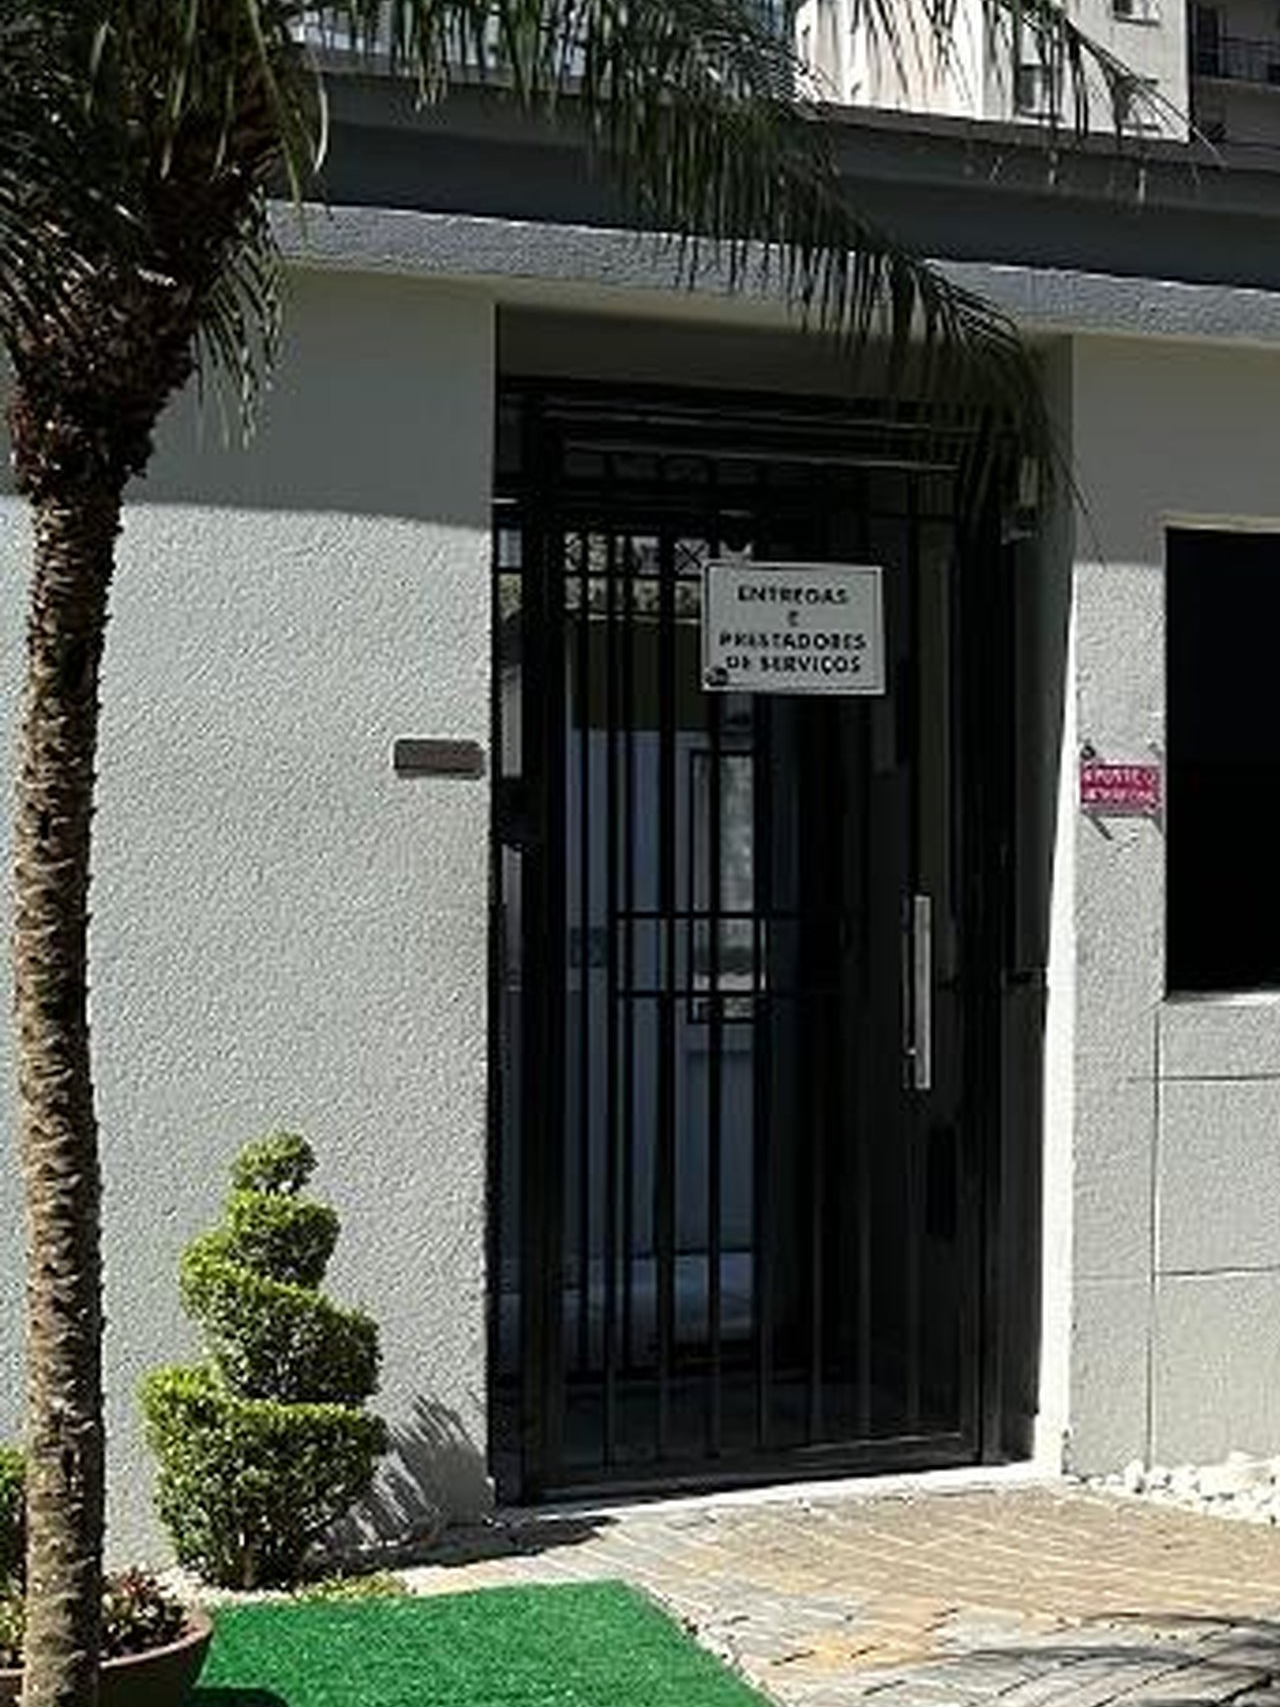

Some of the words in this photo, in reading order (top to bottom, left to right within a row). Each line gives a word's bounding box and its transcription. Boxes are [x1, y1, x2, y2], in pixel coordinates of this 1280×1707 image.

[737, 584, 849, 605] ENTREGAS
[719, 632, 867, 650] PRESTADORES
[726, 655, 751, 670] DE
[760, 655, 861, 675] SERVIÇOS
